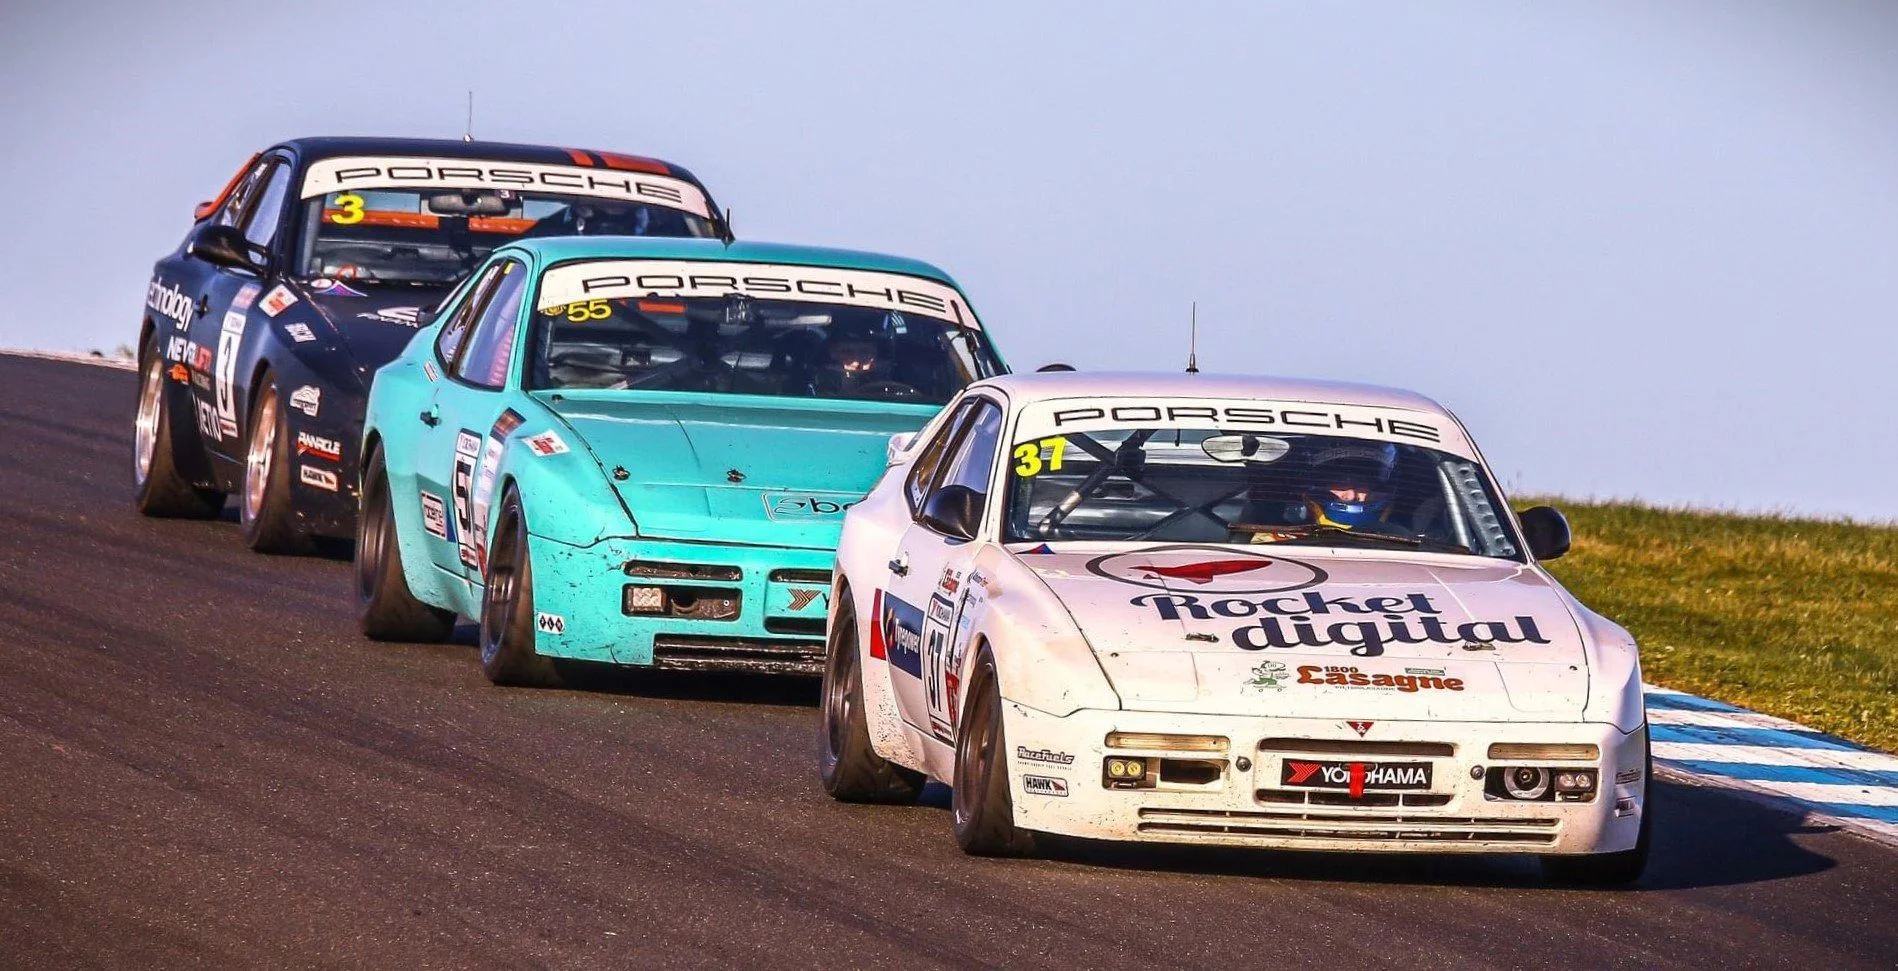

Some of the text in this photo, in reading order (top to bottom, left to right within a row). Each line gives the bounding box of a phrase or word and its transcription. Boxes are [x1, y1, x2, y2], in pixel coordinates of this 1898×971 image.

[335, 167, 682, 203] PORSCHE
[331, 193, 365, 225] 3
[567, 299, 612, 323] 55
[582, 275, 946, 313] PORSCHE
[1054, 407, 1440, 443] PORSCHE
[1014, 436, 1067, 477] 37
[1130, 592, 1442, 621] Rocket
[1232, 614, 1551, 657] digital
[927, 629, 944, 712] 37
[1025, 777, 1052, 791] HAWK
[1321, 766, 1427, 785] YOHAMA
